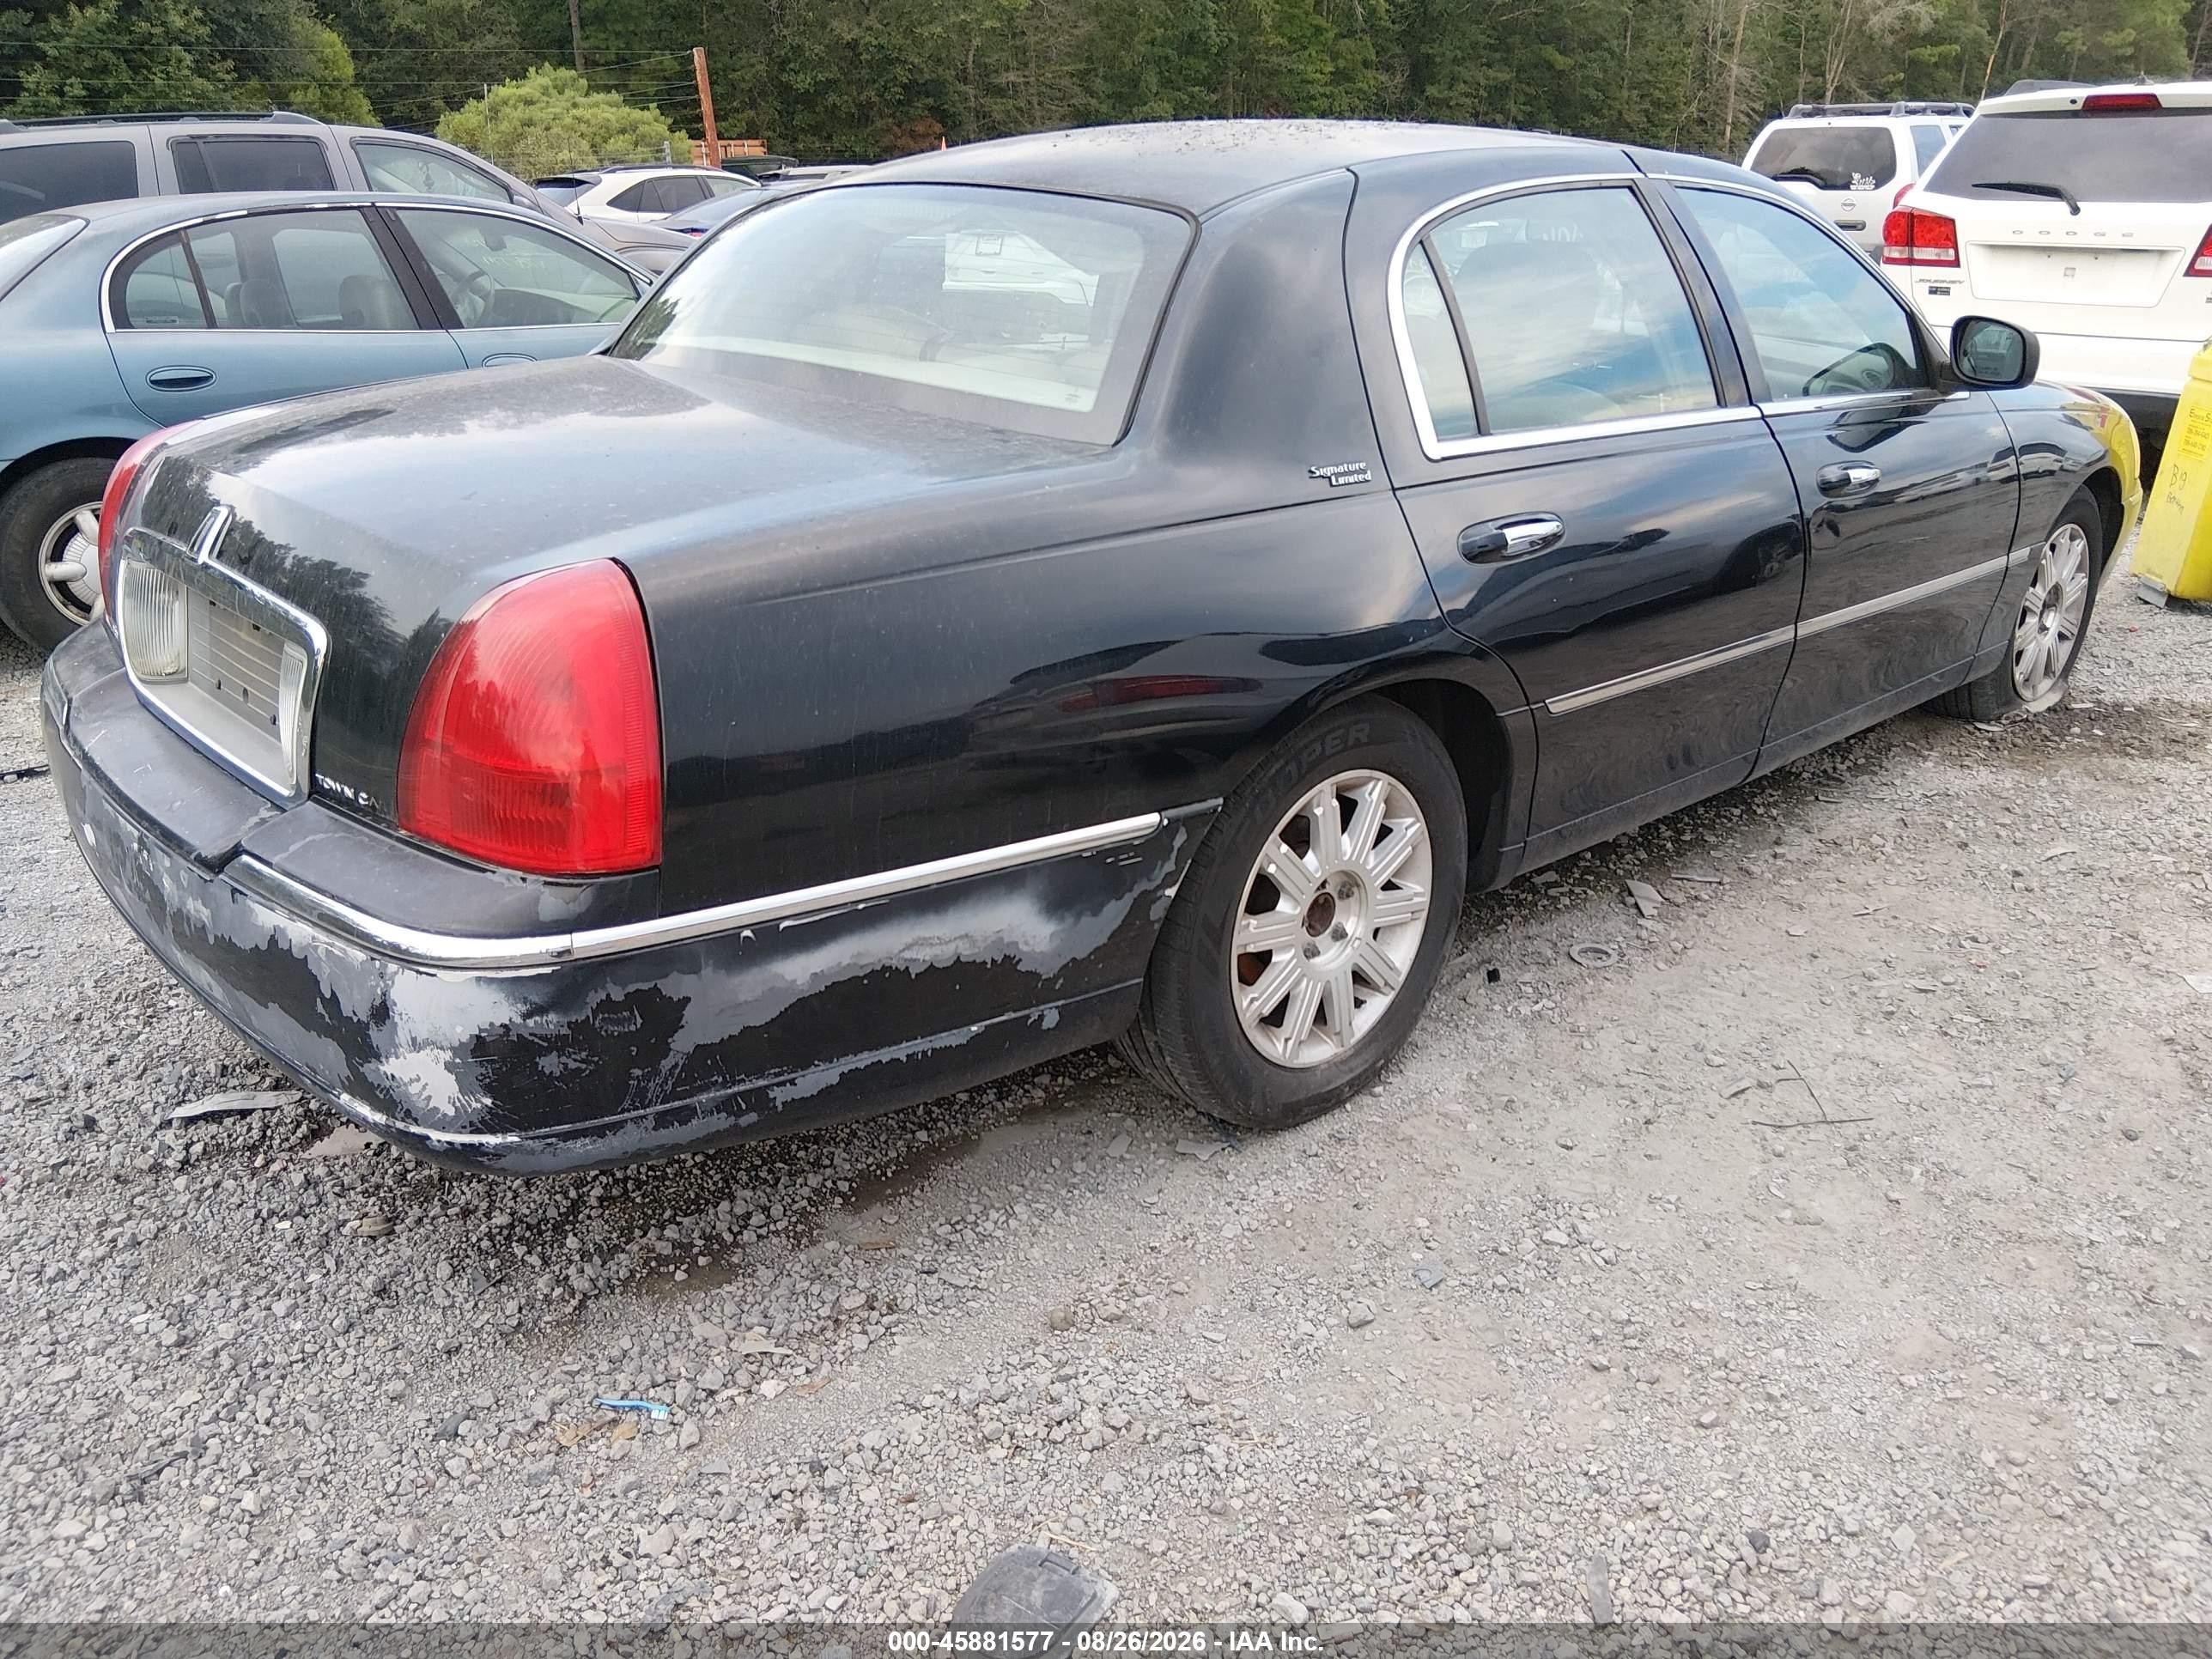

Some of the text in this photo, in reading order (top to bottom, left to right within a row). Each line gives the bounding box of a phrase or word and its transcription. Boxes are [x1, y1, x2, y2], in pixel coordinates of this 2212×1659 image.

[1309, 461, 1367, 477] Signature
[1330, 470, 1372, 487] Limited
[315, 773, 355, 800] TOWN
